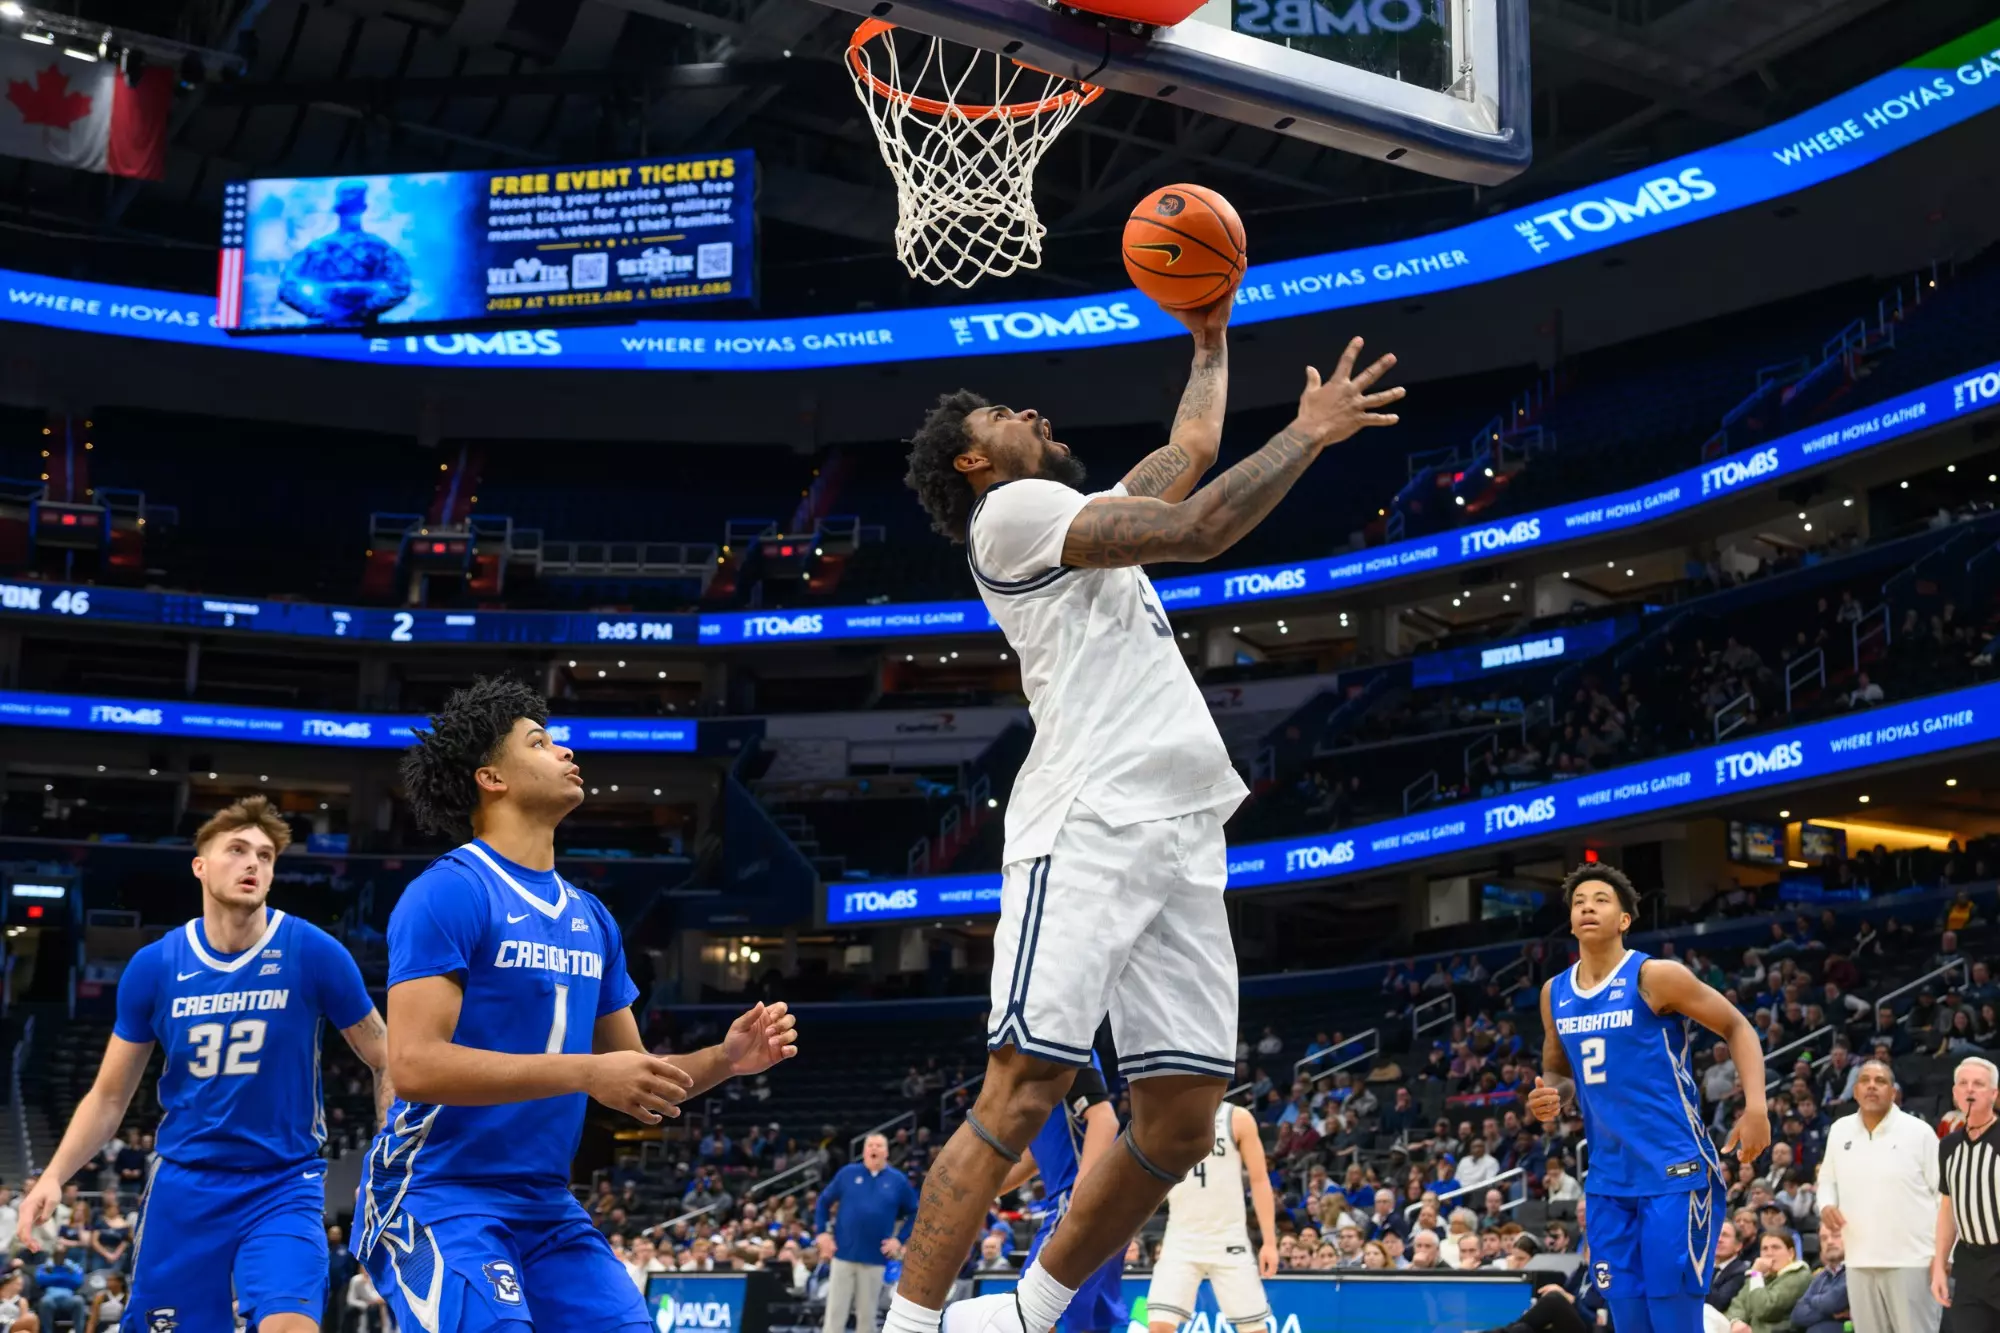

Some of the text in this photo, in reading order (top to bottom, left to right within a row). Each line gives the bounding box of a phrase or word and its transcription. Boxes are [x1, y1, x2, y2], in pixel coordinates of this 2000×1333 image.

[1773, 117, 1866, 165] WHERE
[1861, 78, 1954, 129] HOYAS
[490, 158, 735, 196] FREE EVENT TICKETS
[1514, 167, 1717, 254] THE TOMBS
[1235, 250, 1470, 306] ERE HOYAS GATHER
[9, 289, 101, 315] WHERE
[110, 304, 199, 326] HOYAS
[949, 302, 1140, 345] THE TOMBS
[621, 329, 893, 353] WHERE HOYAS GATHER
[1963, 370, 2000, 404] TO
[1802, 401, 1927, 455] WHERE HOYAS GATHER
[1709, 447, 1778, 490] TOMBS
[1565, 486, 1681, 527] WHERE HOYAS GATHER
[1470, 518, 1541, 553] TOMBS
[1236, 568, 1306, 596] TOMBS
[52, 590, 90, 616] 46
[391, 612, 414, 641] 2
[597, 622, 672, 640] 9:05 PM
[754, 614, 823, 637] TOMBS
[99, 706, 163, 725] TOMBS
[312, 720, 371, 738] TOMBS
[1830, 709, 1974, 753] WHERE HOYAS GATHER
[1725, 741, 1803, 780] TOMBS
[1577, 771, 1692, 808] WHERE HOYAS GATHER
[1494, 796, 1556, 830] TOMBS
[1295, 840, 1355, 870] TOMBS
[854, 889, 918, 912] TOMBS
[494, 940, 602, 979] CREIGHTON
[171, 989, 289, 1018] CREIGHTON
[1556, 1009, 1633, 1035] CREIGHTON
[188, 1020, 268, 1078] 32
[1580, 1037, 1607, 1084] 2
[1193, 1162, 1206, 1188] 4
